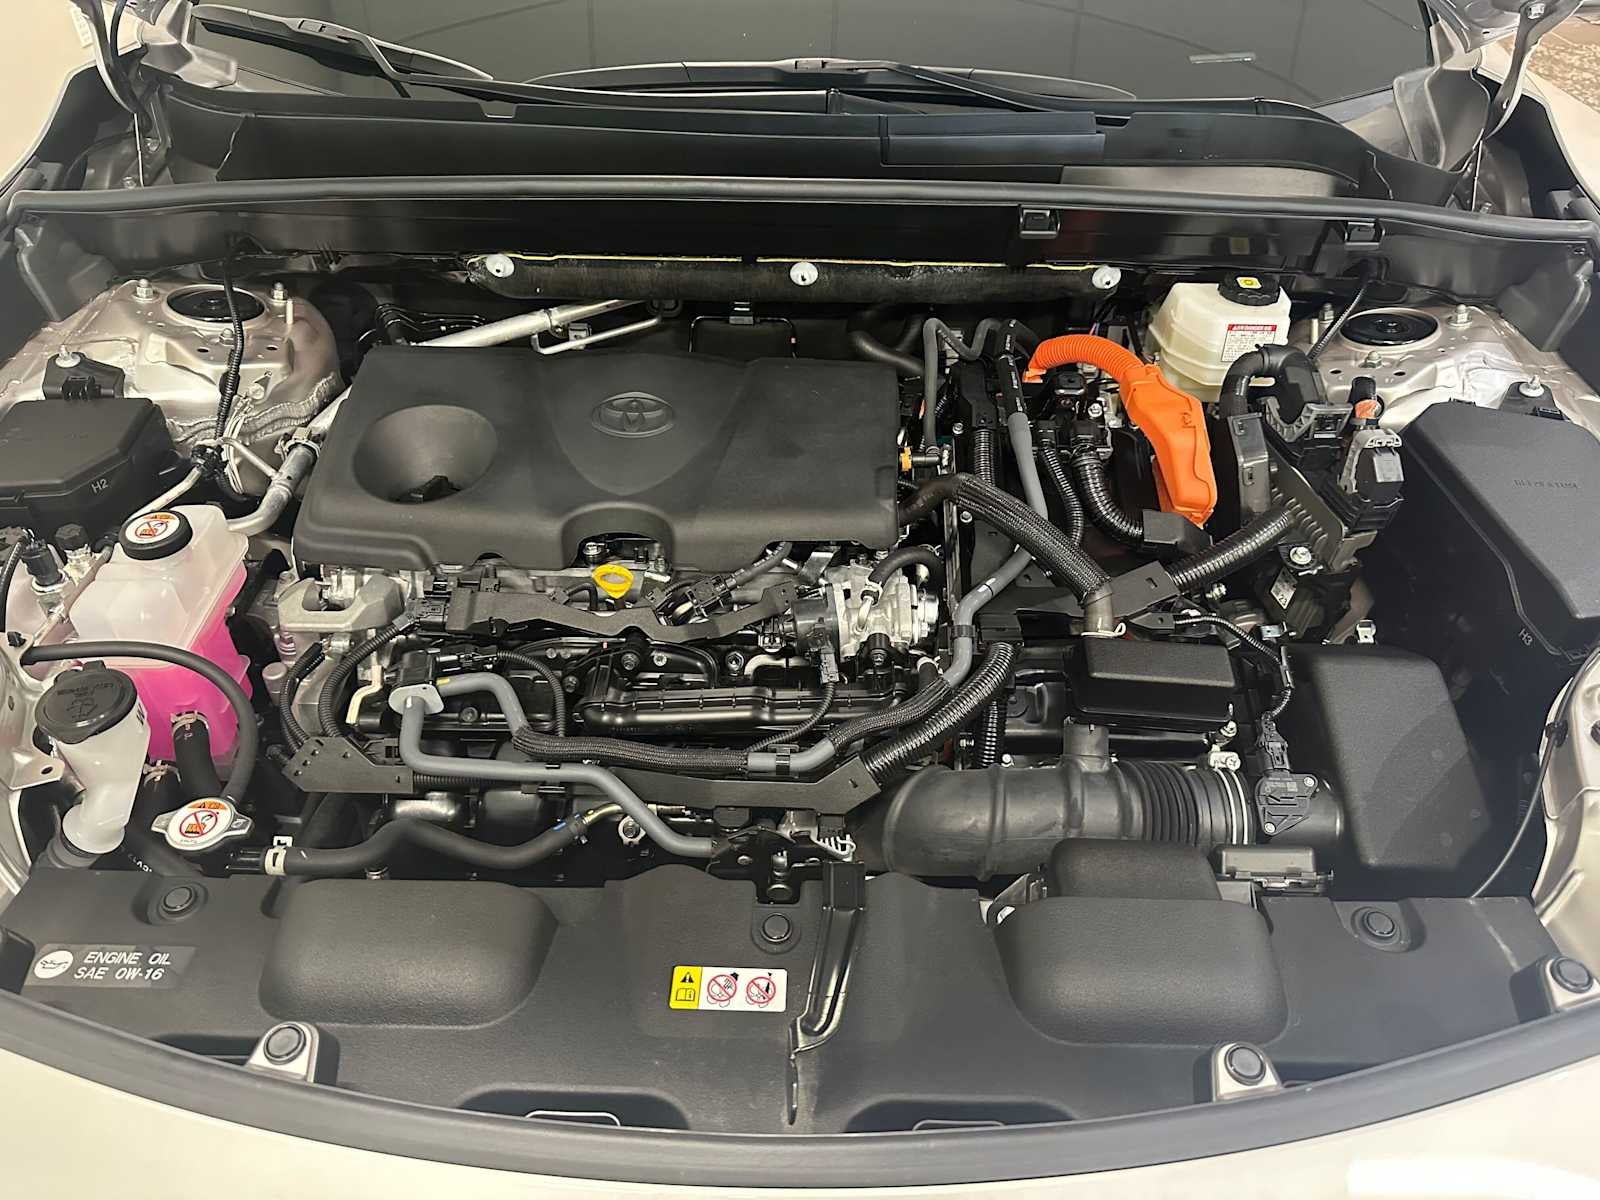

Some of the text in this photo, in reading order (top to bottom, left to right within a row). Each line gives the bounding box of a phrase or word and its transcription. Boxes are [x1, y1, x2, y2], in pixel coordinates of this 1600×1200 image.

[91, 479, 108, 493] H2
[1519, 628, 1533, 645] H3
[84, 951, 171, 965] ENGINE OIL
[74, 966, 164, 980] SAE 0W-16
